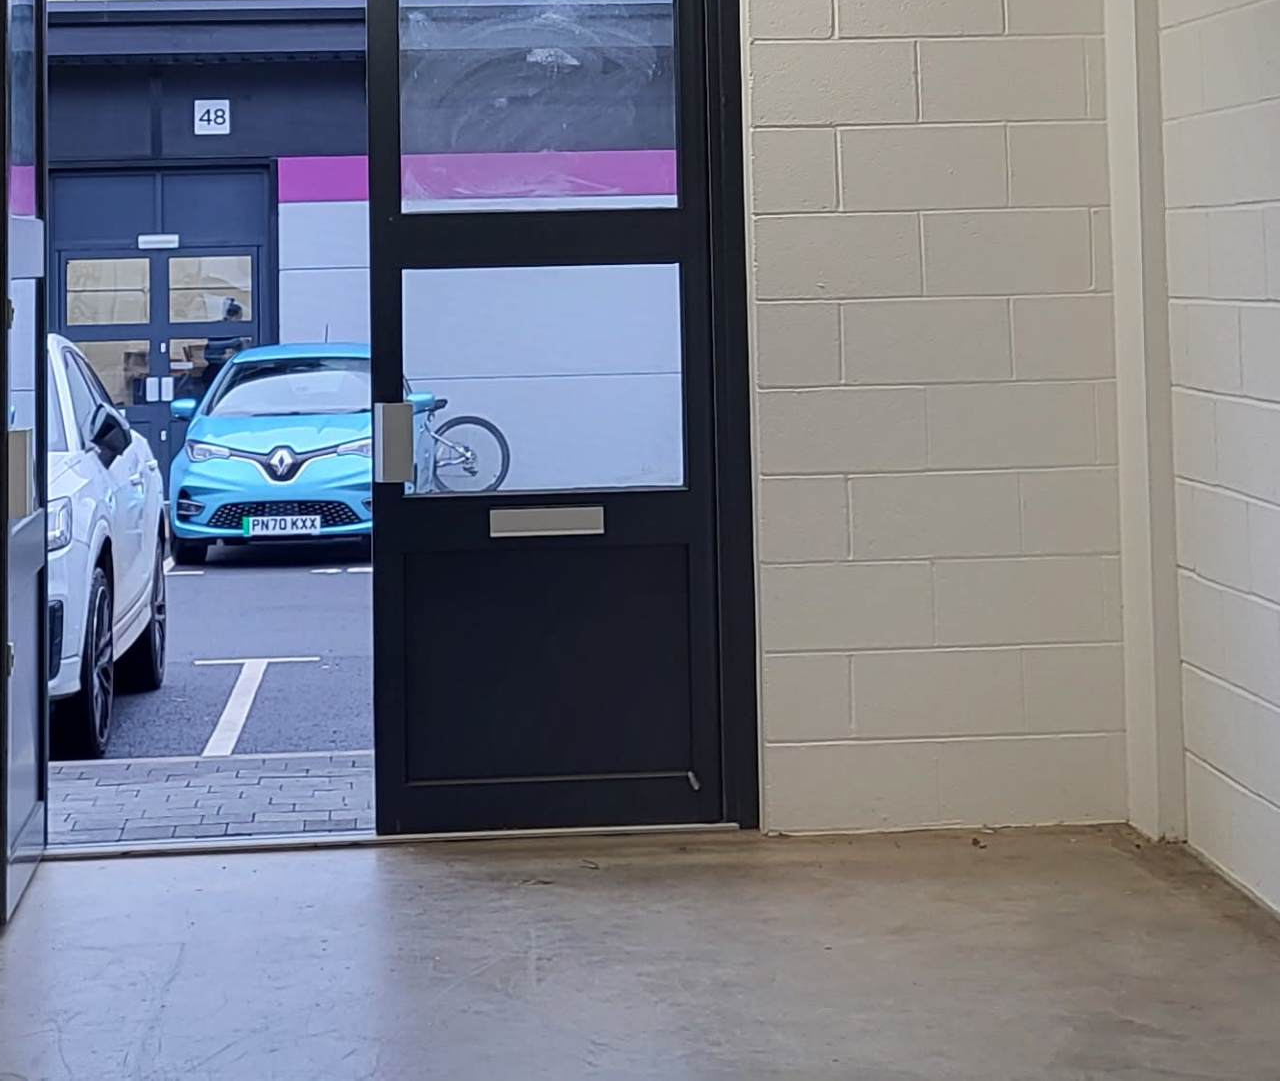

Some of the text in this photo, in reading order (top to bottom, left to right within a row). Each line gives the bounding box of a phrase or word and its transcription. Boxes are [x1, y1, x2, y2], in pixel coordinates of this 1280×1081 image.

[199, 108, 226, 125] 48
[252, 517, 317, 531] PN70 KXX
